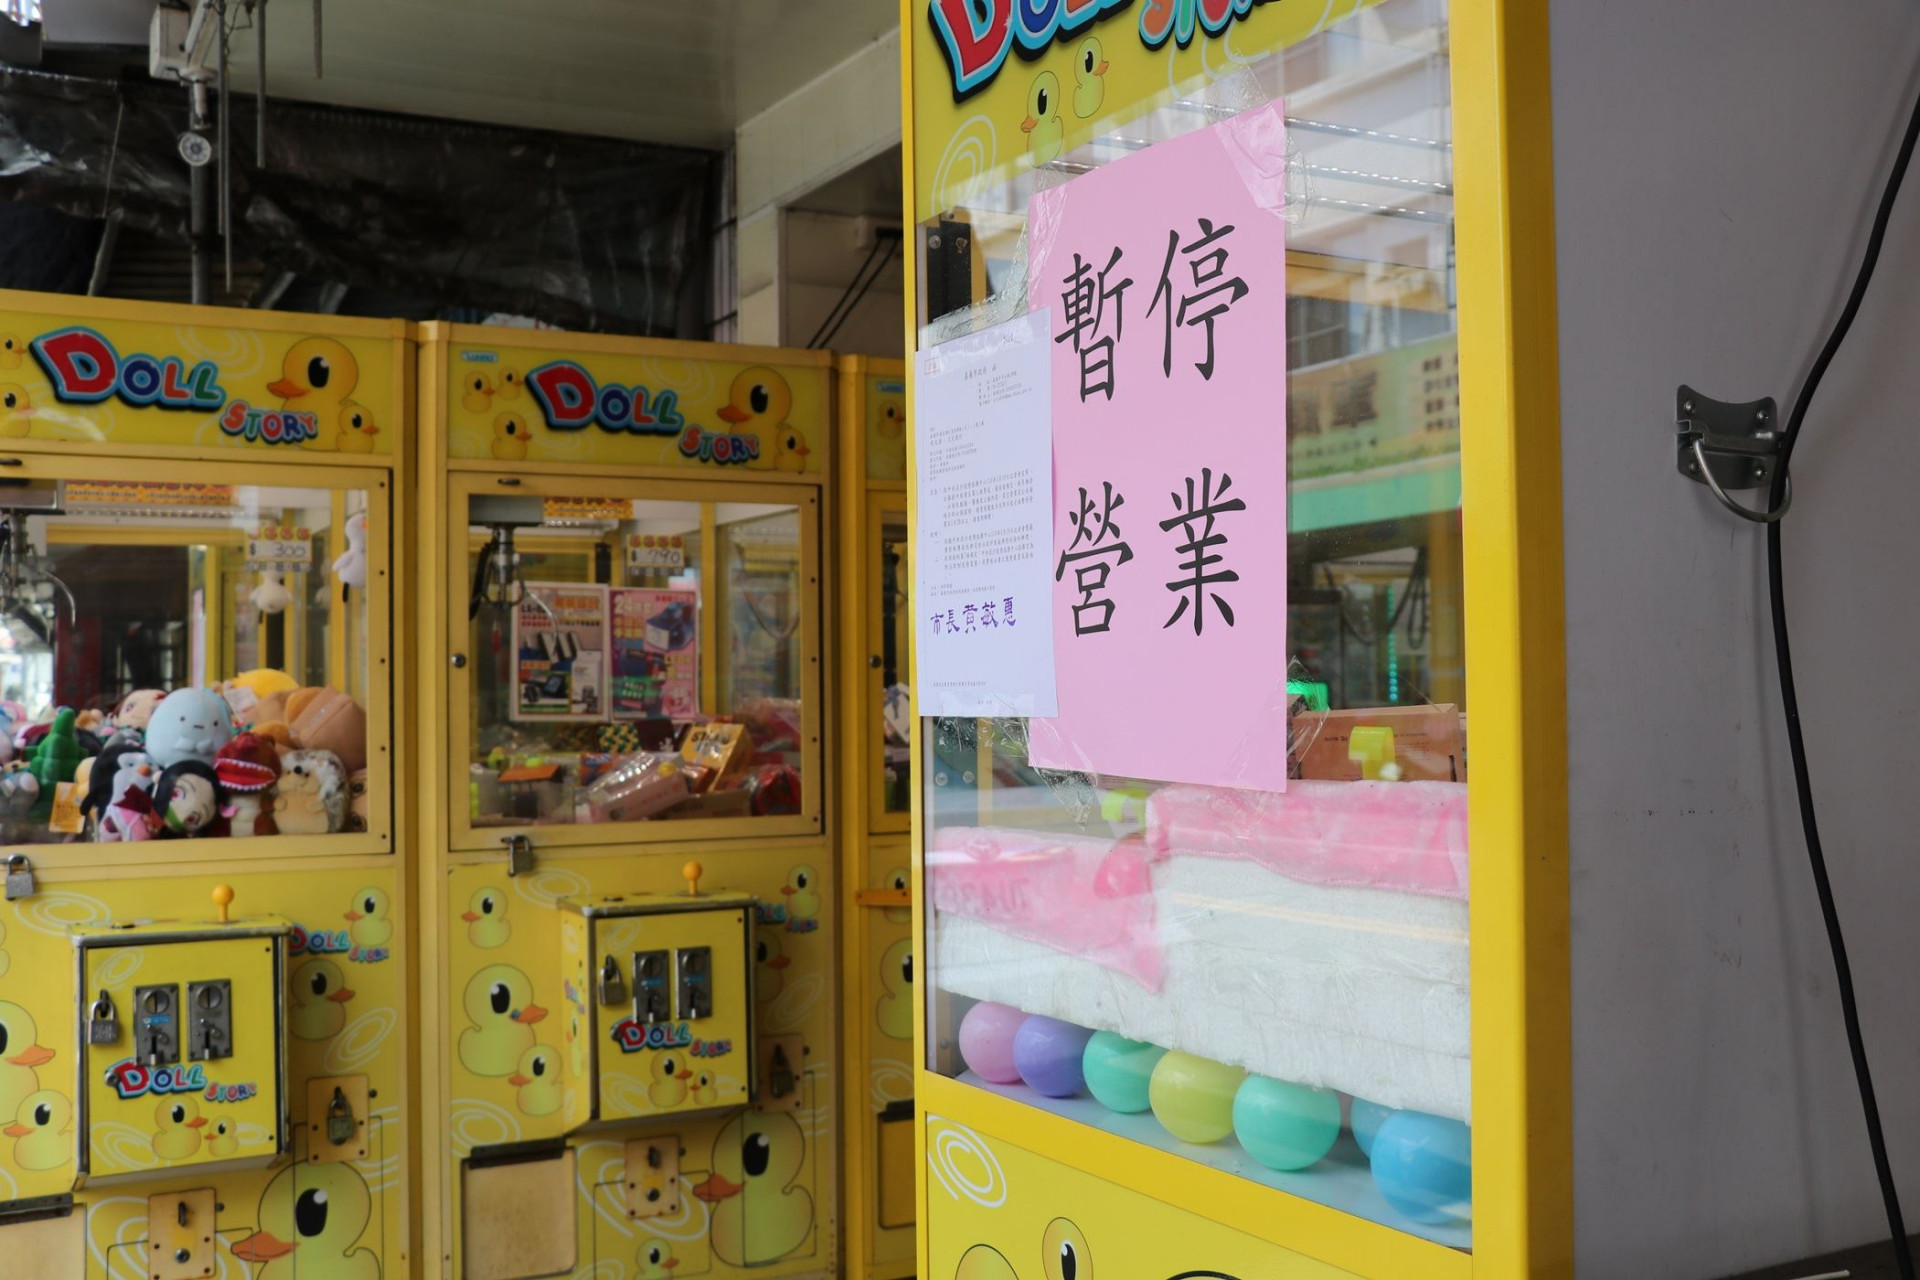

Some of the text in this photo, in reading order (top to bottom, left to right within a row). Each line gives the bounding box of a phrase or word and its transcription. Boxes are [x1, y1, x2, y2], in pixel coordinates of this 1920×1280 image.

[1054, 218, 1249, 403] 暫停
[29, 326, 319, 444] DOLL STORY
[525, 359, 760, 464] DOLL STORY
[273, 542, 306, 558] 300
[648, 548, 681, 563] 790
[1055, 468, 1247, 637] 營業
[611, 1014, 693, 1054] DOLL
[106, 1057, 257, 1103] DOLL STORY
